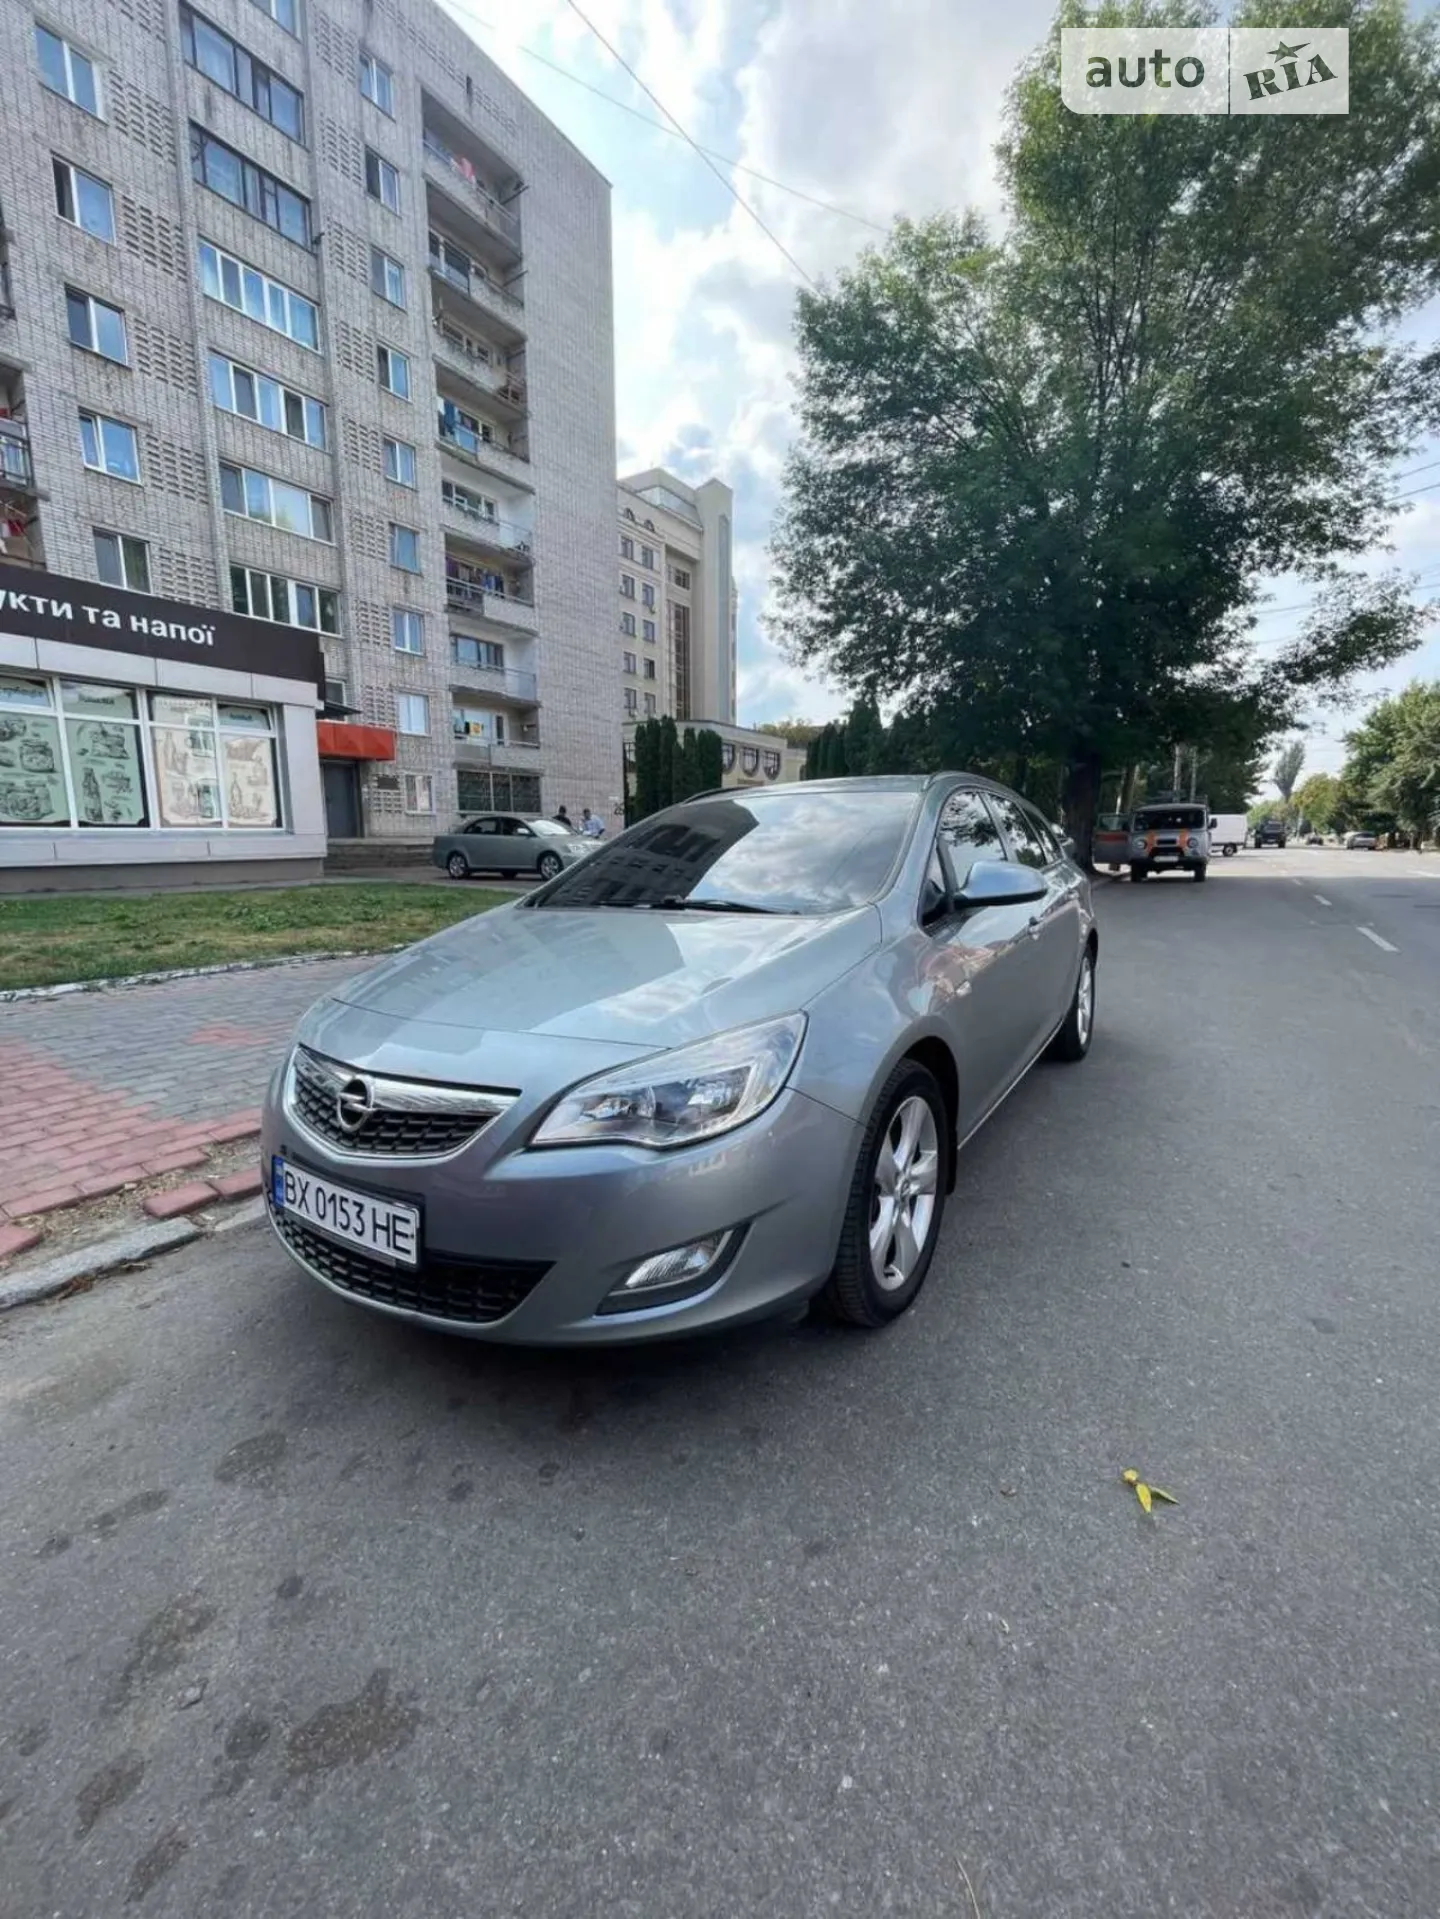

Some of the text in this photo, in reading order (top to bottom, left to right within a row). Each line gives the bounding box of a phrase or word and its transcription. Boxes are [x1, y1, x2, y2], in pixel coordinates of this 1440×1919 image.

[81, 605, 121, 629] та
[130, 614, 216, 646] напої
[315, 1187, 365, 1237] 0153
